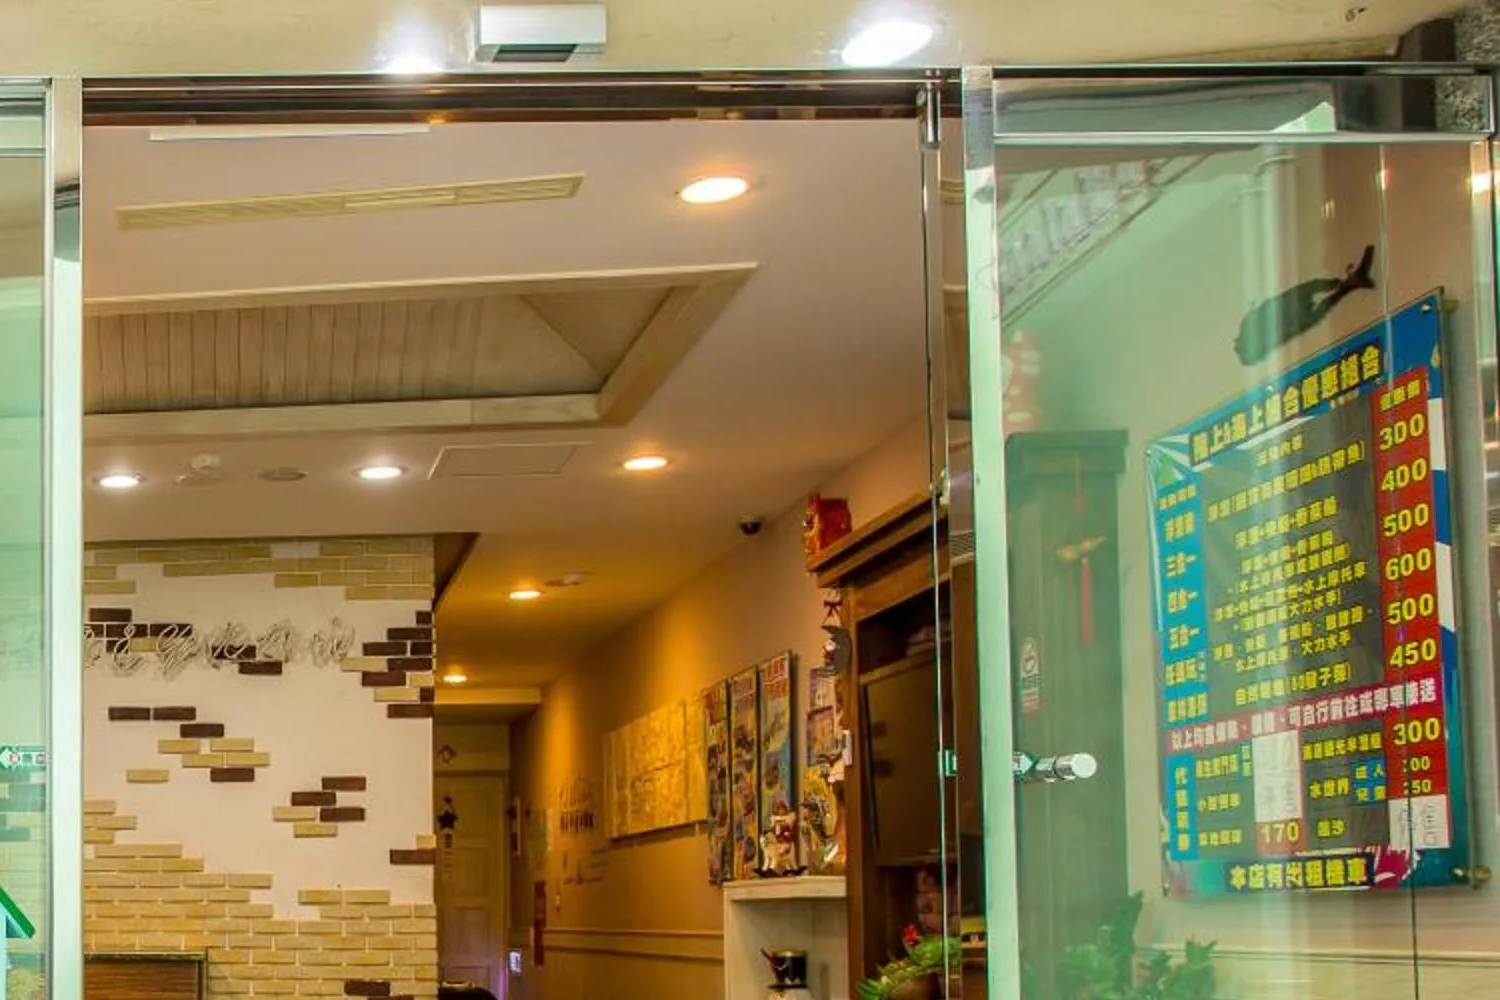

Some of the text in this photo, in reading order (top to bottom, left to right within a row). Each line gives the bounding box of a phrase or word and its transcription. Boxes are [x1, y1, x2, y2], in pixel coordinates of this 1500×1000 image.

[1379, 411, 1423, 452] 300
[1380, 455, 1427, 495] 400
[1383, 501, 1429, 538] 500
[1385, 546, 1431, 582] 600
[1387, 591, 1434, 626] 500
[1389, 636, 1436, 669] 450
[1392, 716, 1440, 746] 300
[1262, 821, 1299, 844] 170
